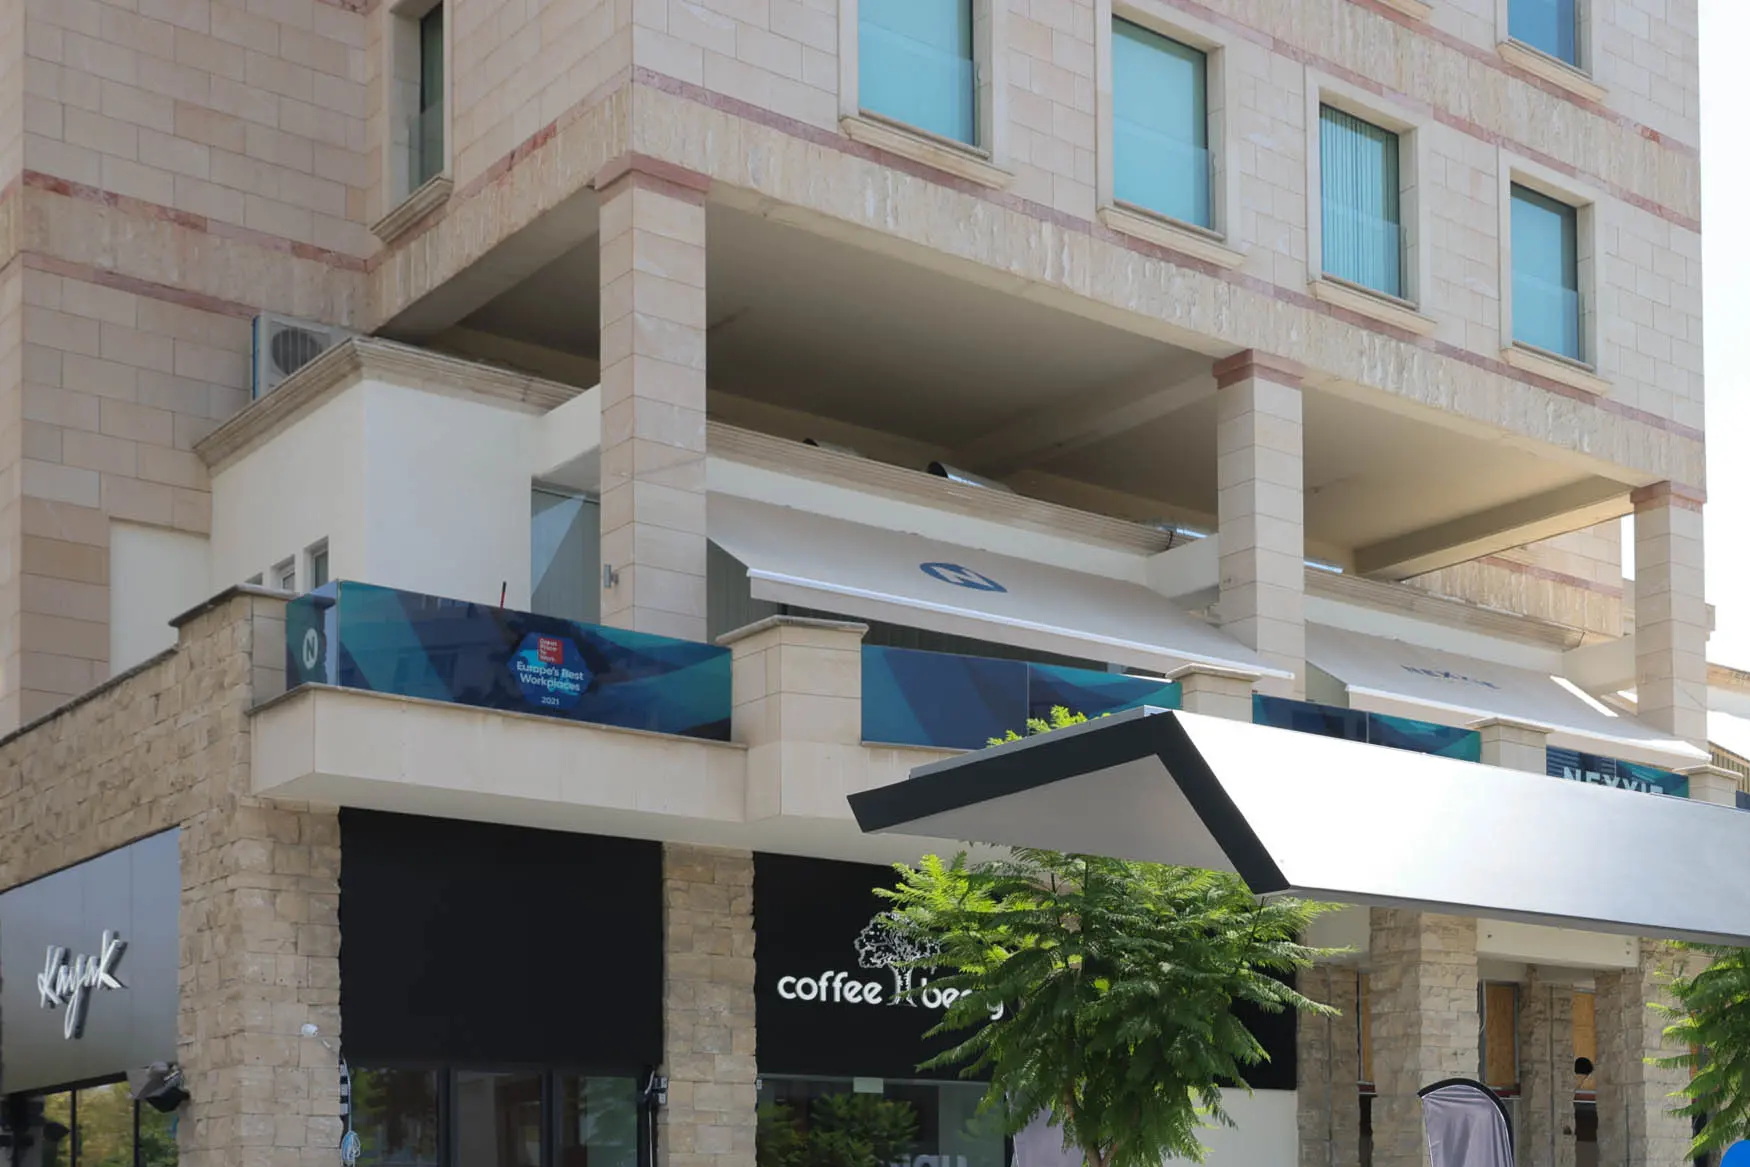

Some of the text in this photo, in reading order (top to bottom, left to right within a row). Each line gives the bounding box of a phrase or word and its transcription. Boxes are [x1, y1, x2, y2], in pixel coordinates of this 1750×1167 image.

[516, 660, 584, 681] Europe's Best
[519, 673, 580, 692] Workplaces
[541, 696, 560, 705] 2021
[37, 929, 124, 1040] Kayak
[777, 970, 883, 1005] coffee
